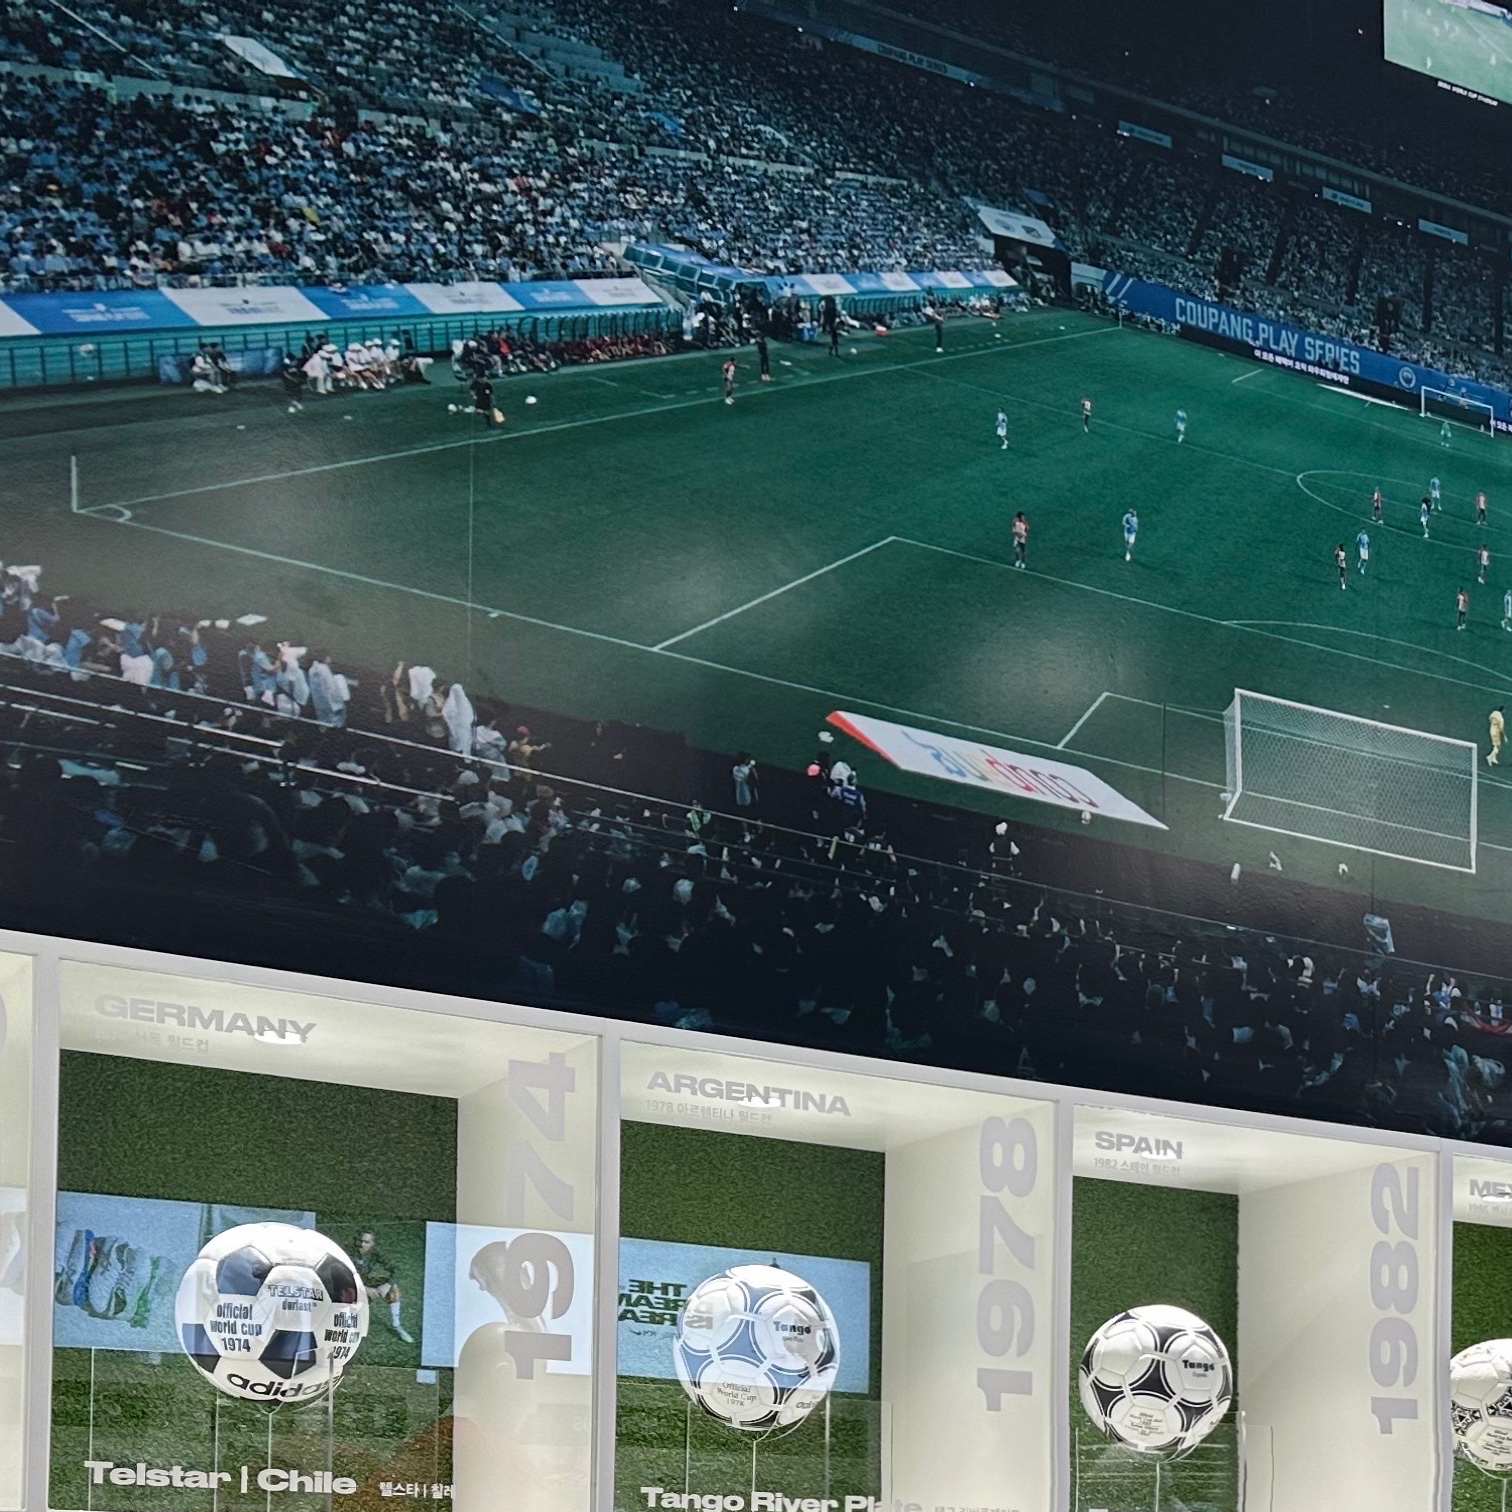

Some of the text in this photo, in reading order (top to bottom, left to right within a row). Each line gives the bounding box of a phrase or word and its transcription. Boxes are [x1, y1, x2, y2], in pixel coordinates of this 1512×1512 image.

[1175, 297, 1360, 374] COUPANG PLAY SERIES
[95, 994, 317, 1043] GERMANY
[647, 1071, 851, 1116] ARGENTINA
[645, 1099, 674, 1113] 1978
[1095, 1131, 1182, 1159] SPAIN
[1094, 1157, 1117, 1169] 1982
[503, 1052, 576, 1380] 1974
[977, 1115, 1038, 1412] 1978
[268, 1285, 323, 1301] TELSTAR
[1369, 1162, 1420, 1435] 1982
[217, 1303, 252, 1320] official
[210, 1320, 262, 1336] world cup
[324, 1329, 347, 1343] world
[772, 1321, 812, 1335] Tango
[221, 1337, 251, 1352] 1974
[1182, 1360, 1215, 1372] Tango
[227, 1373, 341, 1398] adidas
[722, 1382, 751, 1392] Official
[717, 1387, 757, 1402] World Cup
[727, 1398, 744, 1406] 1978
[84, 1461, 231, 1489] Telstar
[258, 1468, 356, 1494] Chile
[380, 1481, 419, 1498] 텔스타
